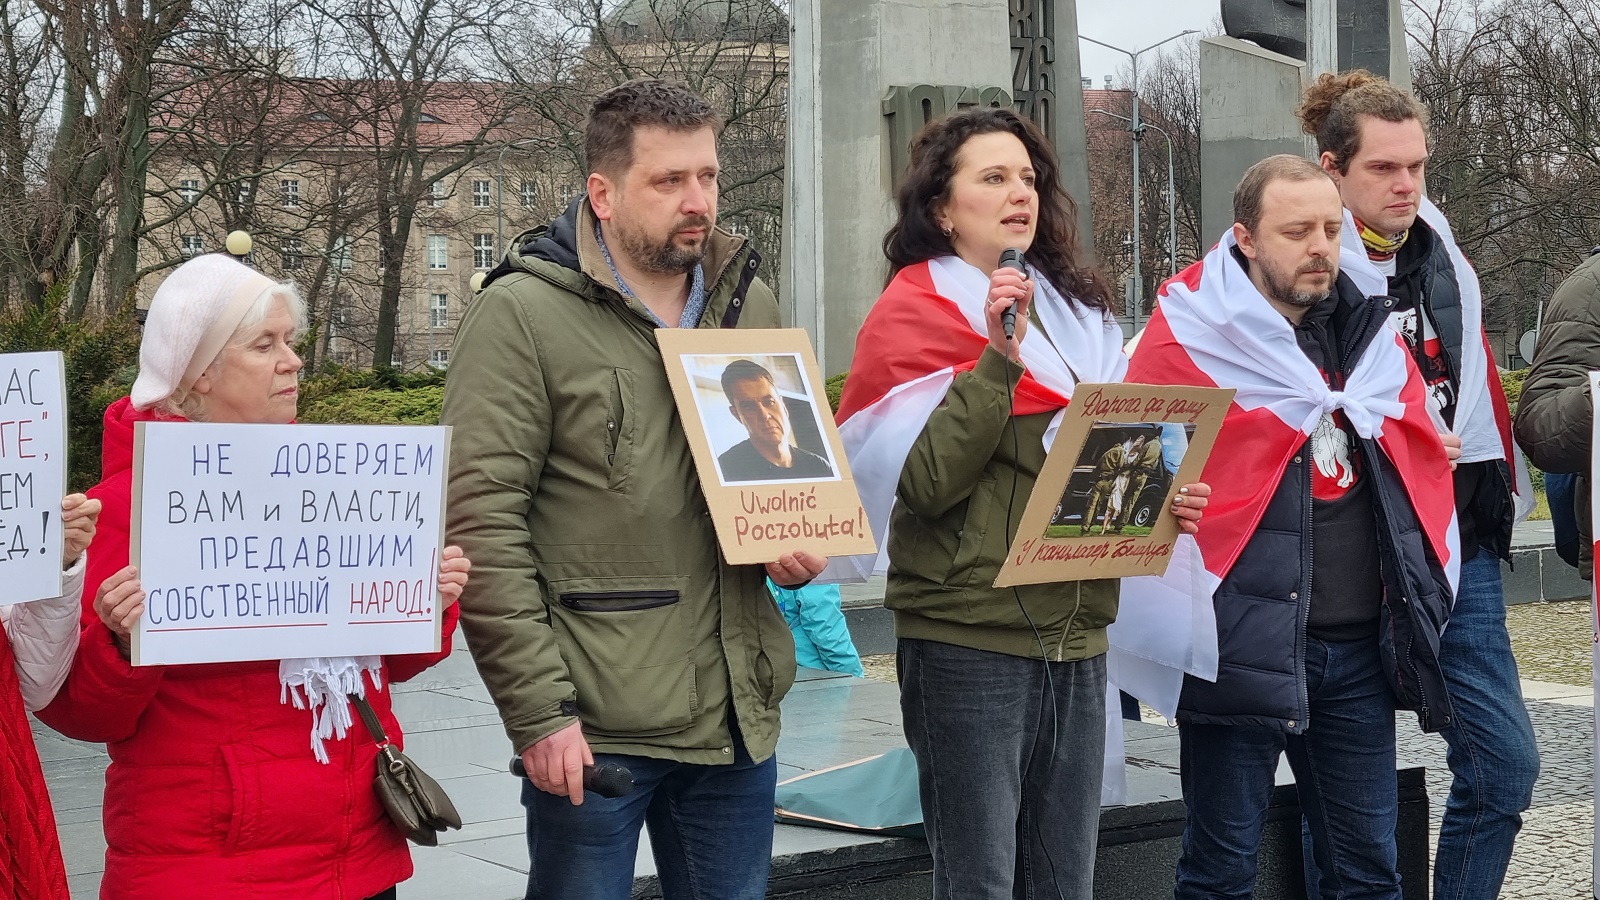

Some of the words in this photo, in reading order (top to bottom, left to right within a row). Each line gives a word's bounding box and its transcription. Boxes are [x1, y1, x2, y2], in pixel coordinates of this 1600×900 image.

[0, 368, 44, 405] АС
[1081, 388, 1142, 418] Дарога
[1141, 397, 1165, 421] да
[192, 444, 233, 476] НЕ
[270, 443, 433, 477] ДОВЕРЯЕМ
[167, 490, 244, 524] ВАМ
[263, 504, 280, 521] и
[301, 489, 424, 528] ВЛАСТИ,
[740, 486, 817, 515] Uwolnić
[734, 507, 864, 546] Poczobuta!
[199, 534, 413, 572] ПРЕДАВШИМ
[148, 576, 330, 626] СОБСТВЕННЫЙ
[349, 547, 437, 619] НАРОД!
